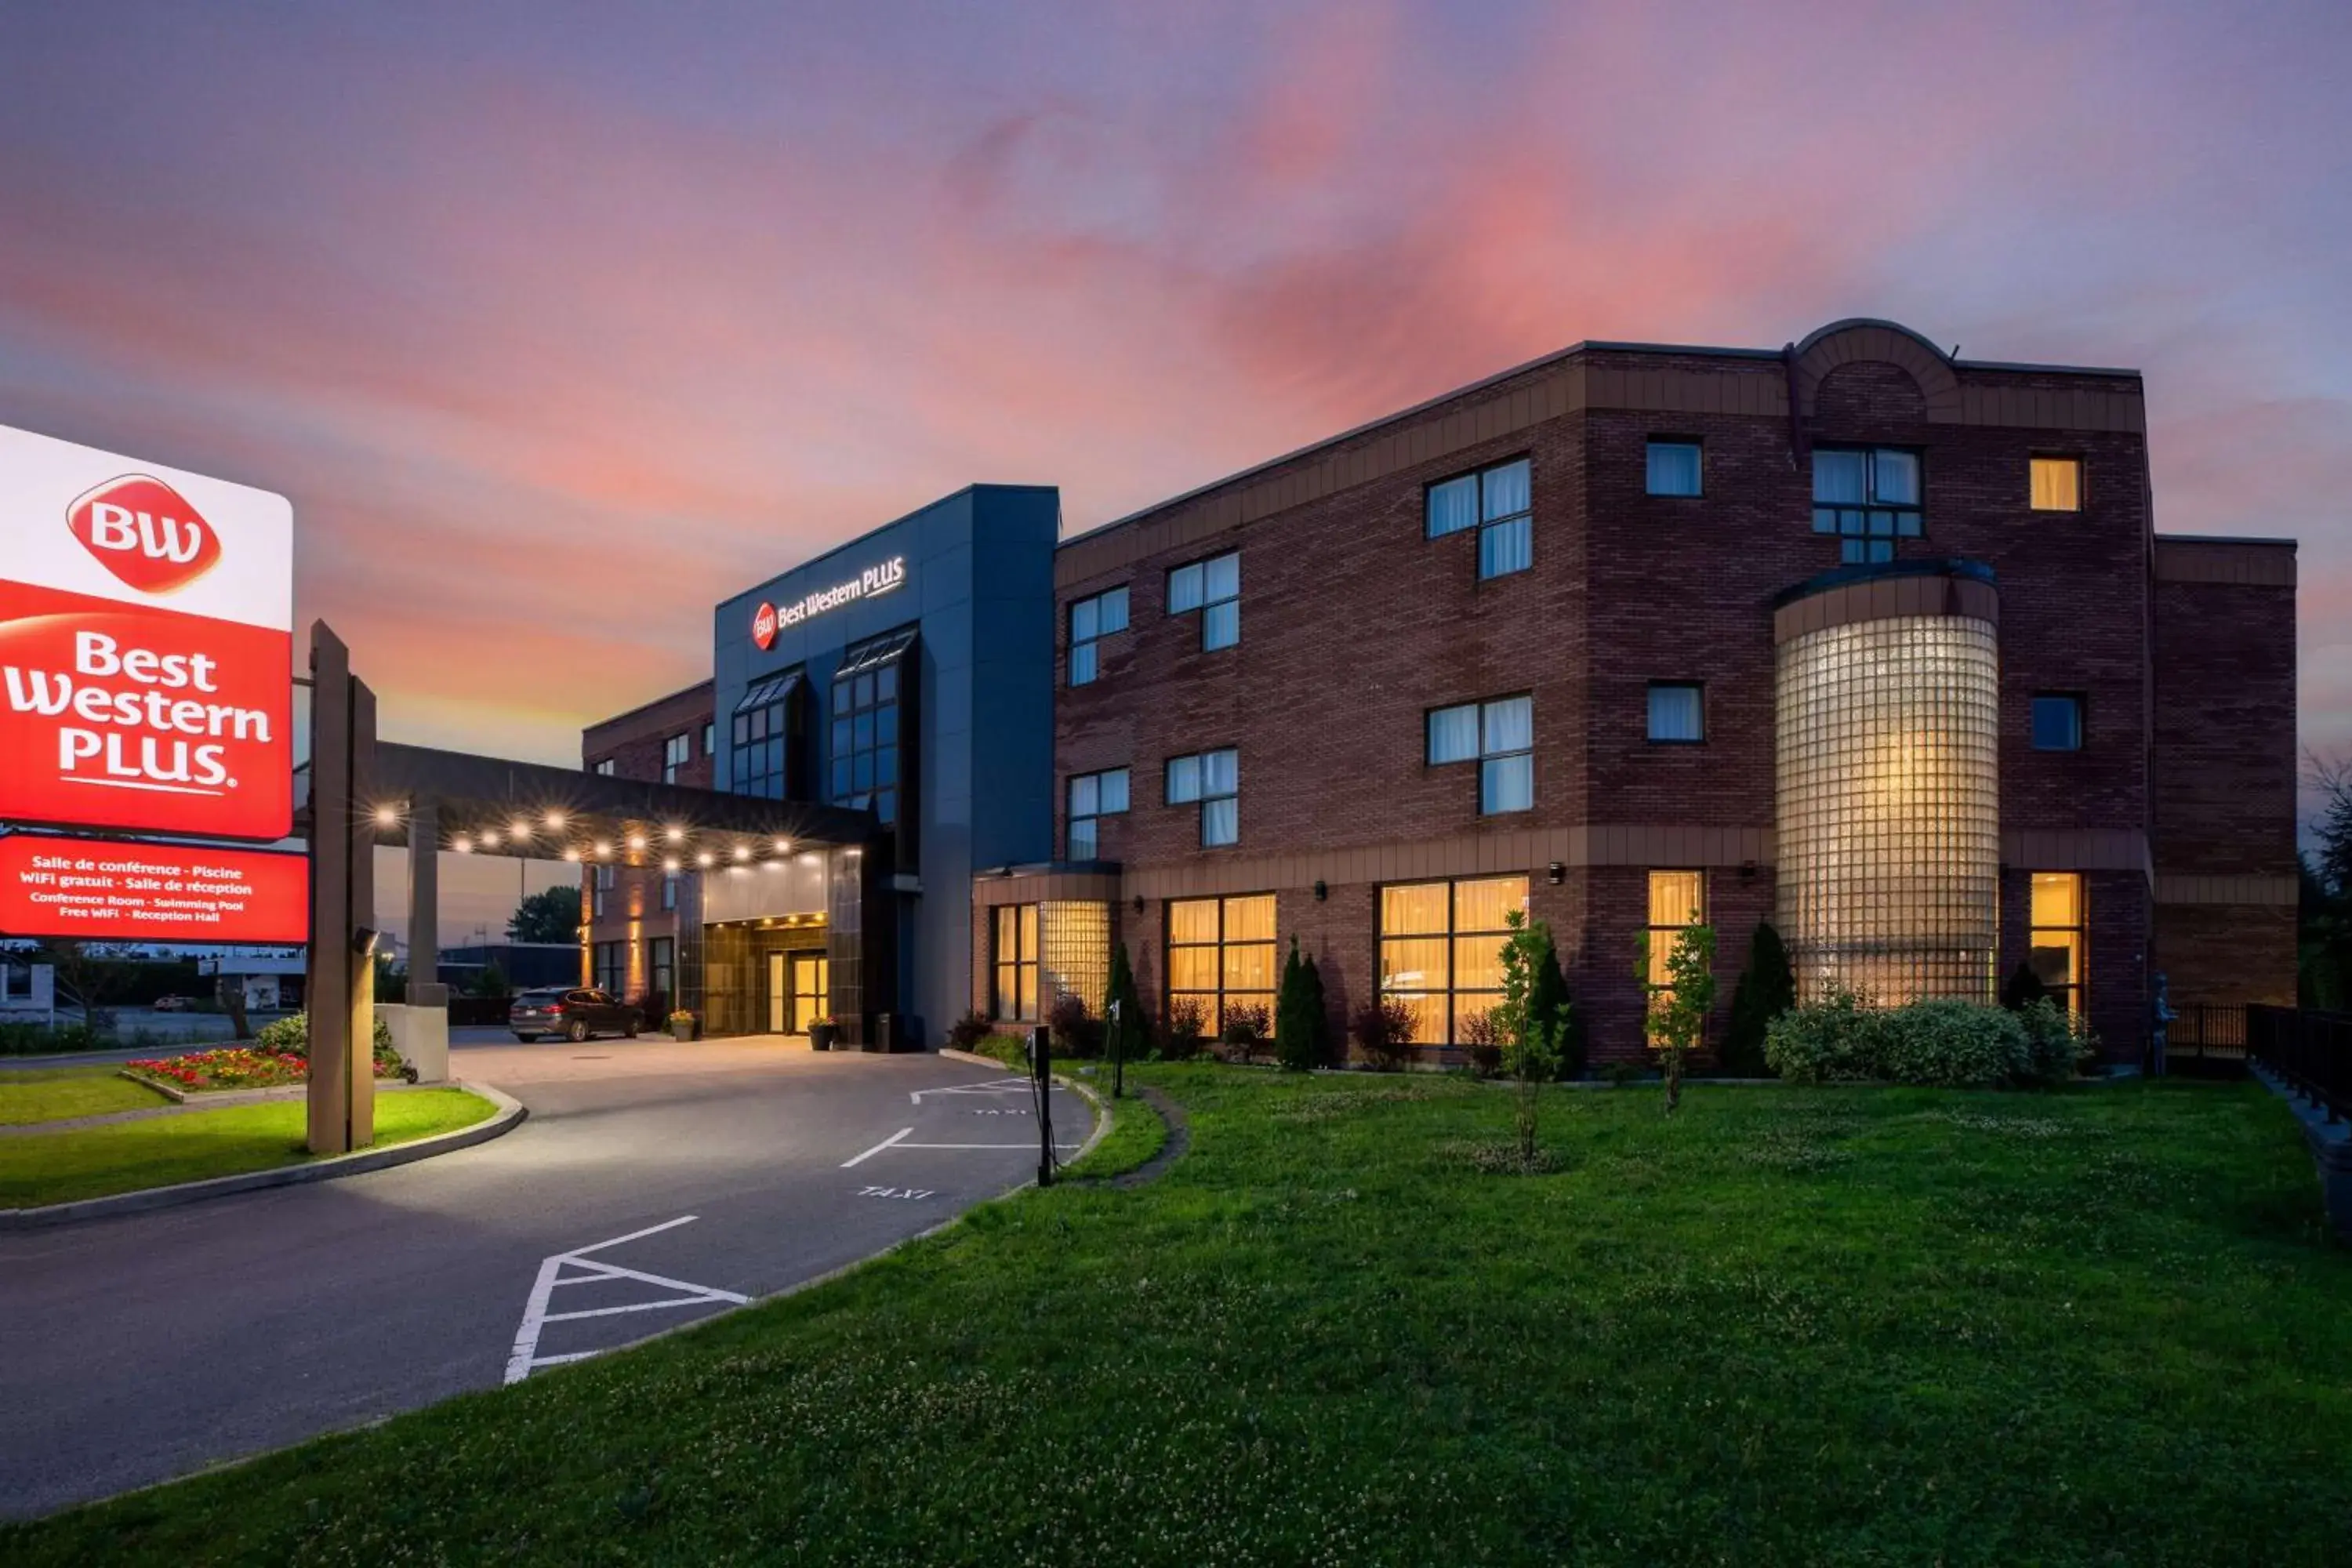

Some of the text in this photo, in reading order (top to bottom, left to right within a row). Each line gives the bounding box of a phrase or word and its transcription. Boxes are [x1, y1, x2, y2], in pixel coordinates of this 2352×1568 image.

[92, 501, 201, 563] BW
[778, 557, 902, 628] Best Western PLUS
[75, 630, 217, 691] Best
[3, 666, 272, 742] Western
[32, 855, 244, 880] Salle de conférence Piscine
[60, 874, 114, 888] gratuit
[125, 877, 162, 891] Salle
[164, 880, 183, 891] de
[186, 881, 252, 895] réception
[30, 891, 244, 911] Conference Room Swimming Pool
[60, 907, 89, 917] Free
[132, 909, 193, 922] Reception
[195, 913, 220, 922] Hall
